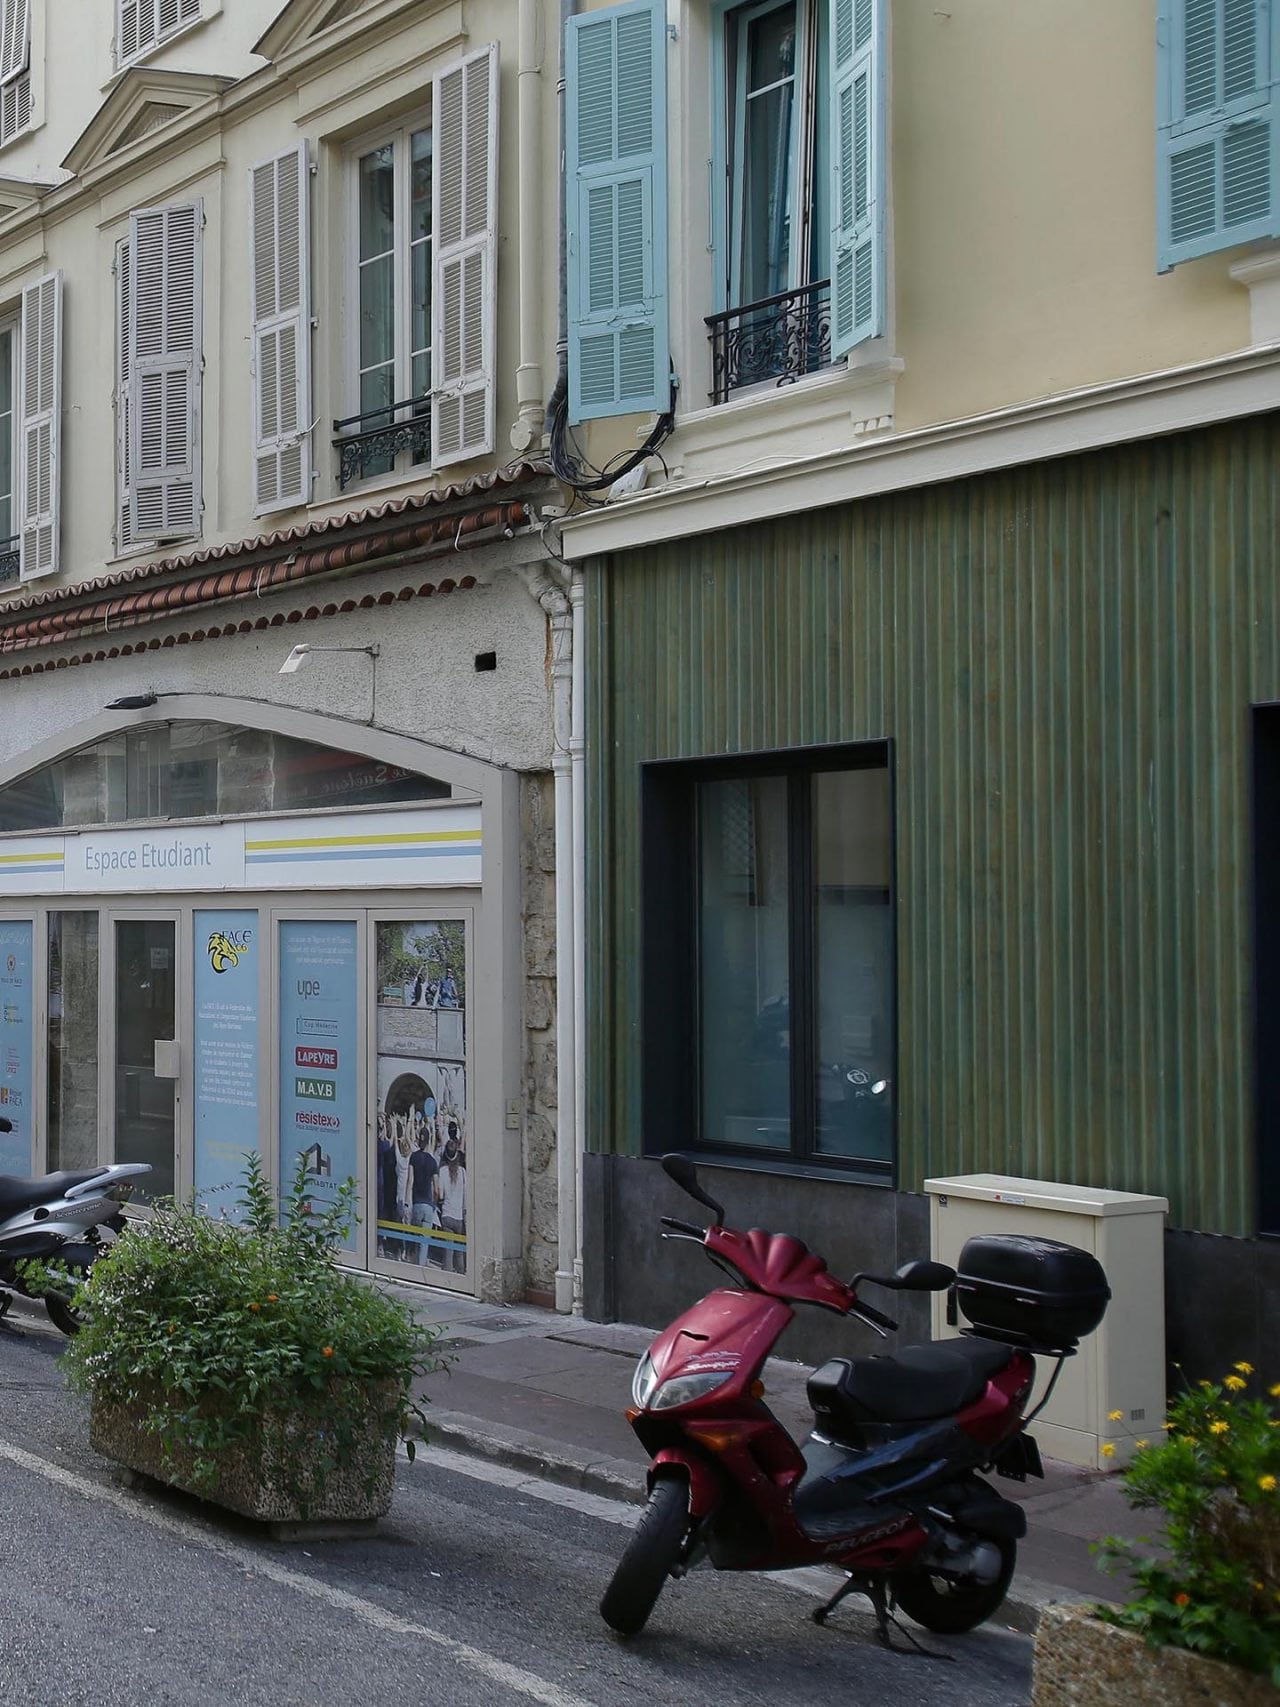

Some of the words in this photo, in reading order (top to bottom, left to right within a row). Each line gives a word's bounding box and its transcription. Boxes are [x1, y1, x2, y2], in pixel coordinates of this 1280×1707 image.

[85, 846, 137, 876] Espace
[141, 840, 212, 868] Etudiant
[297, 980, 320, 1000] upe
[297, 1050, 336, 1065] LAPEYRE
[297, 1081, 333, 1097] M.A.V.B
[824, 1517, 910, 1555] PEUGEOT
